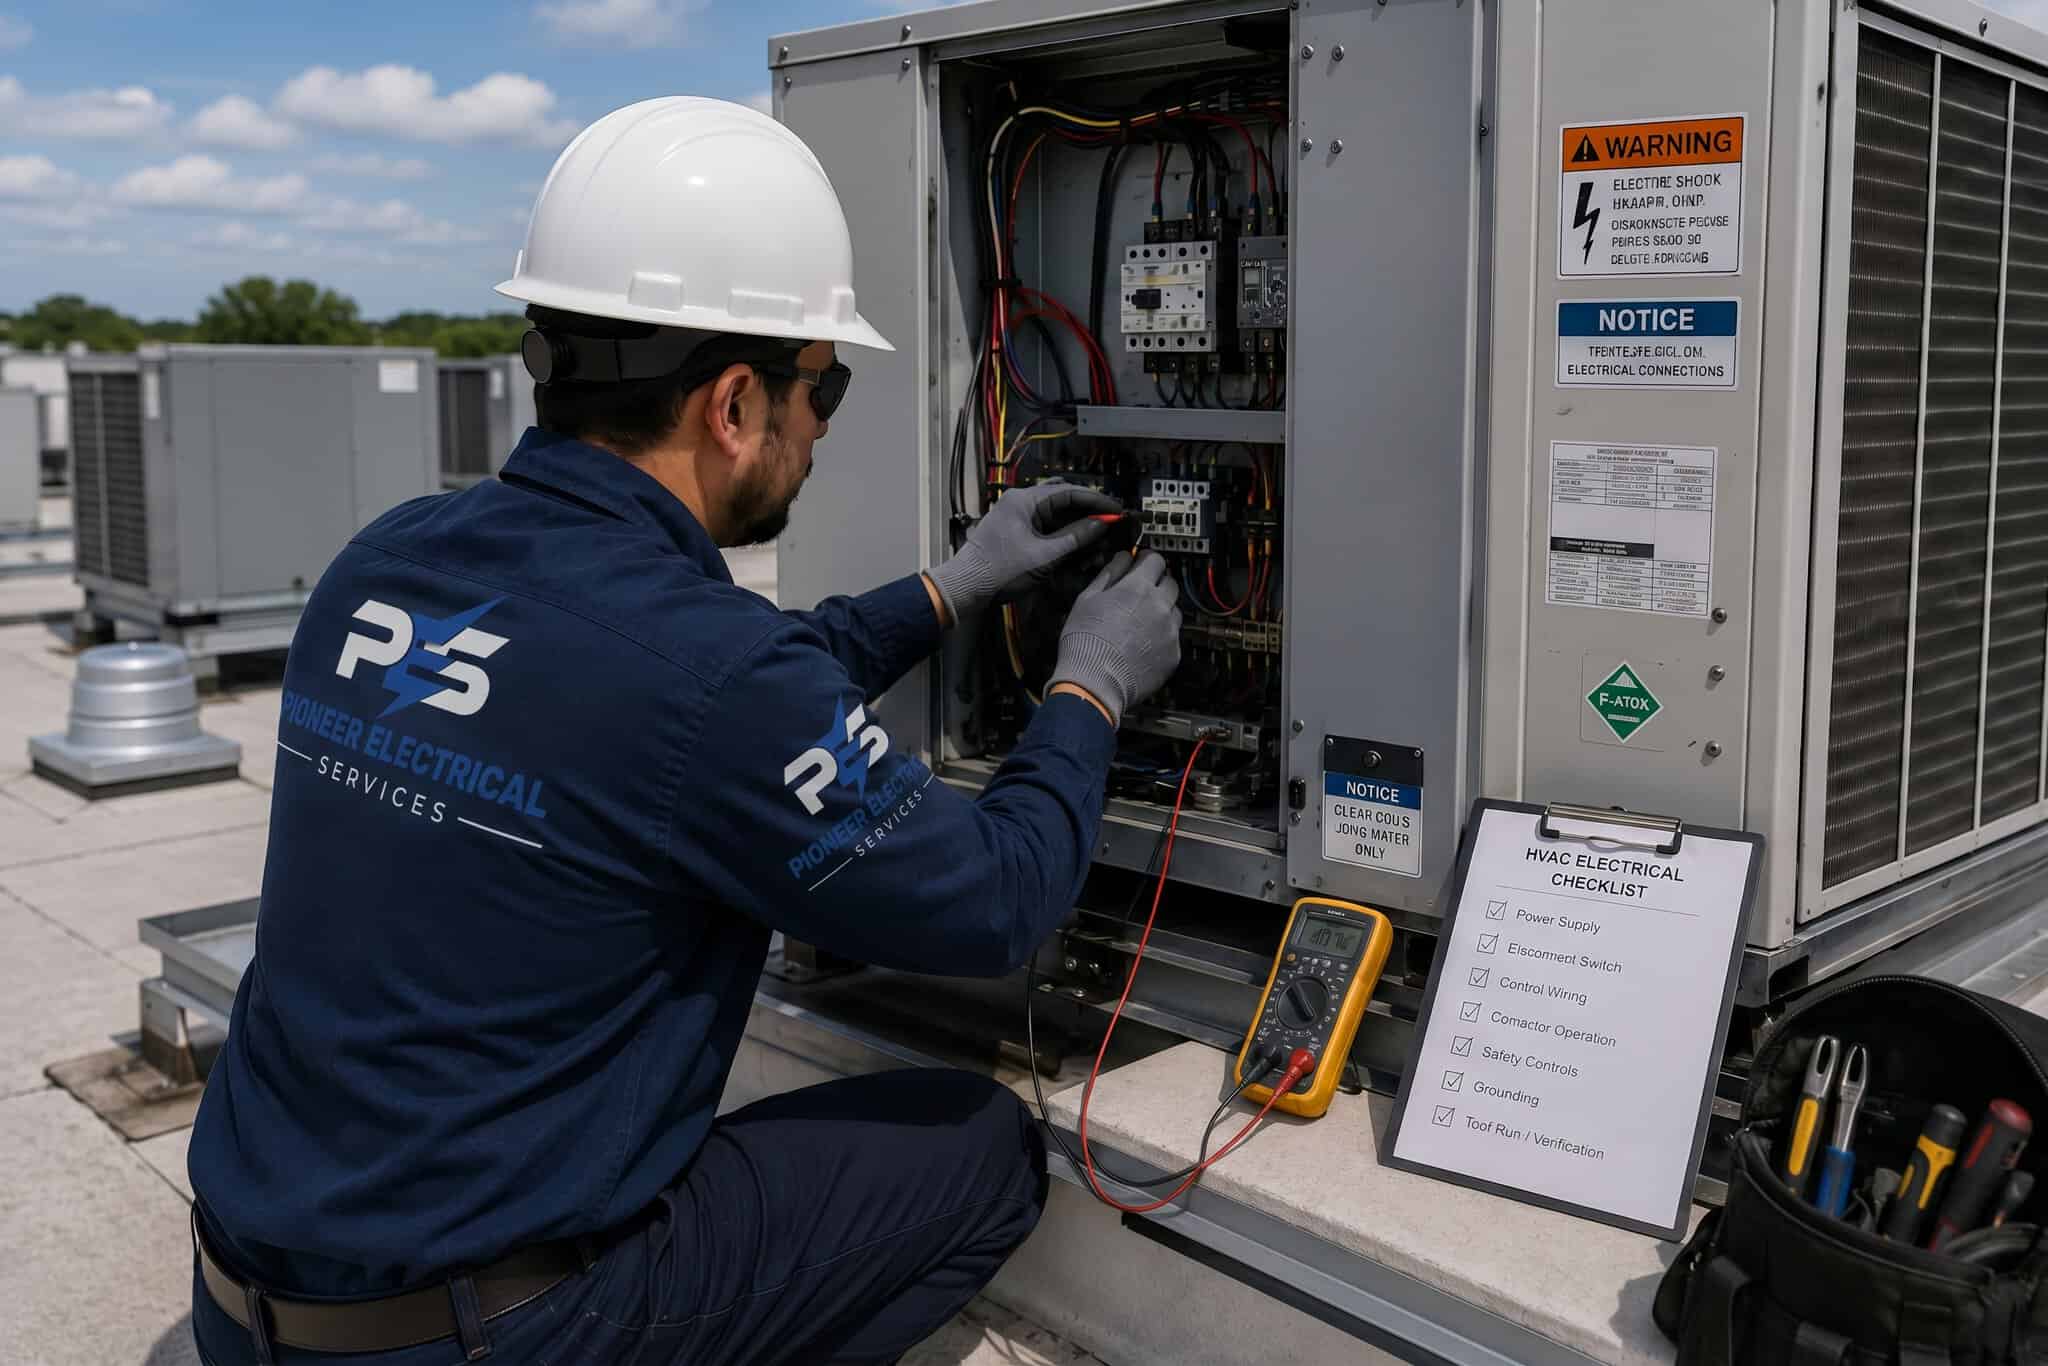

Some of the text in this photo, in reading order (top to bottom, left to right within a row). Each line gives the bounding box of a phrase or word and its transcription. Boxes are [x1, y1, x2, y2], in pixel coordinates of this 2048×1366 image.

[1605, 130, 1732, 159] WARNING
[1600, 308, 1694, 331] NOTICE
[1568, 364, 1724, 377] ELECTRICAL CONNECTIONS
[281, 690, 547, 818] PIONEER ELECTRICAL
[318, 756, 447, 823] SERVICES
[1346, 780, 1400, 803] NOTICE
[855, 790, 923, 857] SERVICES
[1334, 804, 1372, 822] CLEAR
[788, 807, 869, 880] PIONEER
[1371, 828, 1409, 846] MATER
[1355, 843, 1386, 860] ONLY
[1525, 847, 1685, 882] HVAC ELECTRICAL
[1551, 872, 1648, 899] CHECKLIST
[1516, 909, 1600, 936] Power Supply
[1579, 956, 1622, 973] Switch
[1499, 976, 1544, 996] Control
[1554, 1024, 1616, 1047] Operation
[1482, 1046, 1578, 1078] Safety Controls
[1473, 1081, 1540, 1108] Grounding
[1494, 1123, 1522, 1140] Run
